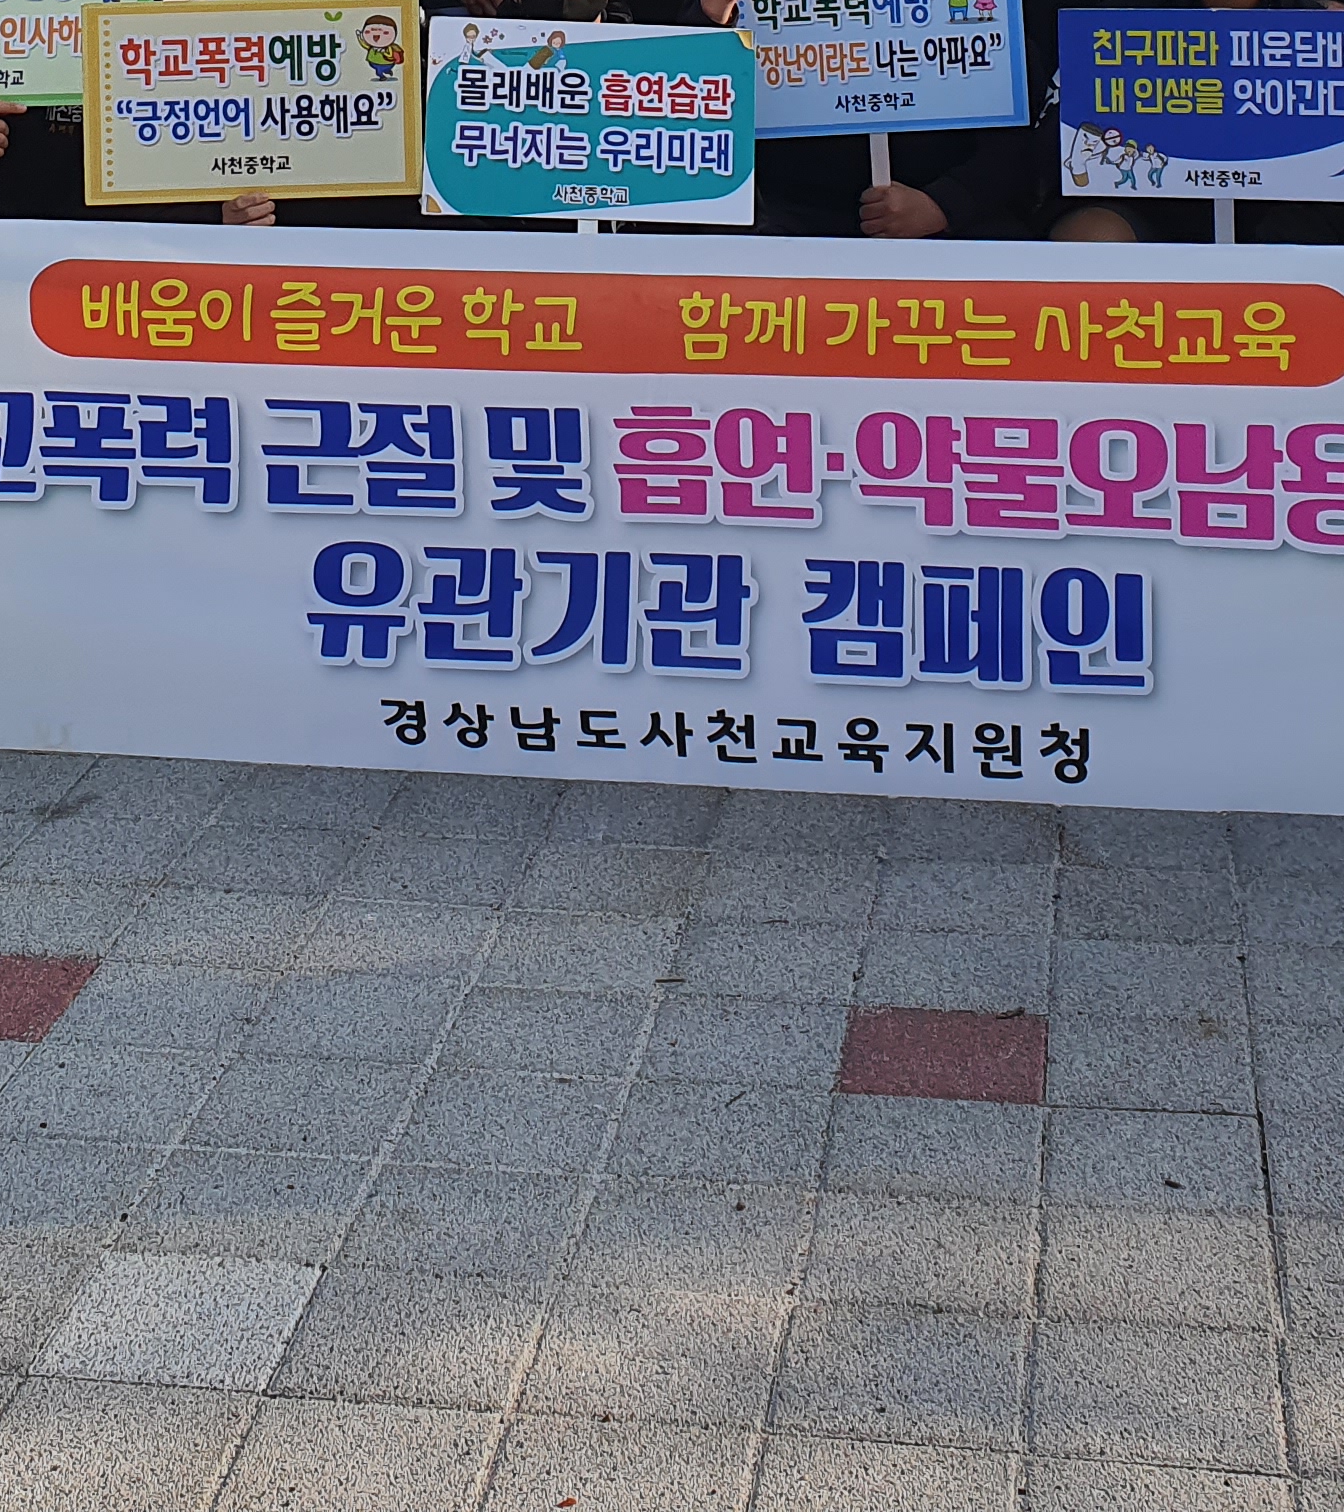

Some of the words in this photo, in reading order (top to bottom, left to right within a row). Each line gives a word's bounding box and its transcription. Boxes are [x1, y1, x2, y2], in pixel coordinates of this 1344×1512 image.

[119, 34, 342, 86] 학교폭력예방
[875, 39, 919, 80] 나는
[1093, 29, 1219, 68] 친구따라
[456, 68, 589, 112] 몰래배운
[601, 74, 732, 118] 흡연습관
[835, 91, 916, 113] 사천중학교
[1094, 77, 1124, 114] 내
[1134, 77, 1224, 115] 인생을
[211, 154, 292, 176] 사천중학교
[455, 123, 588, 166] 무너지는
[599, 129, 731, 172] 우리미래
[553, 184, 629, 205] 사천중학교
[1184, 168, 1263, 187] 사천중학교
[81, 278, 253, 348] 배움이
[269, 282, 442, 354] 즐거운
[462, 286, 584, 356] 학교
[679, 290, 806, 361] 함께
[824, 296, 1017, 366] 가꾸는
[1034, 298, 1297, 371] 사천교육
[261, 398, 457, 510] 근절
[484, 406, 588, 513] 및
[306, 540, 752, 671] 유관기관
[803, 558, 1146, 688] 캠페인
